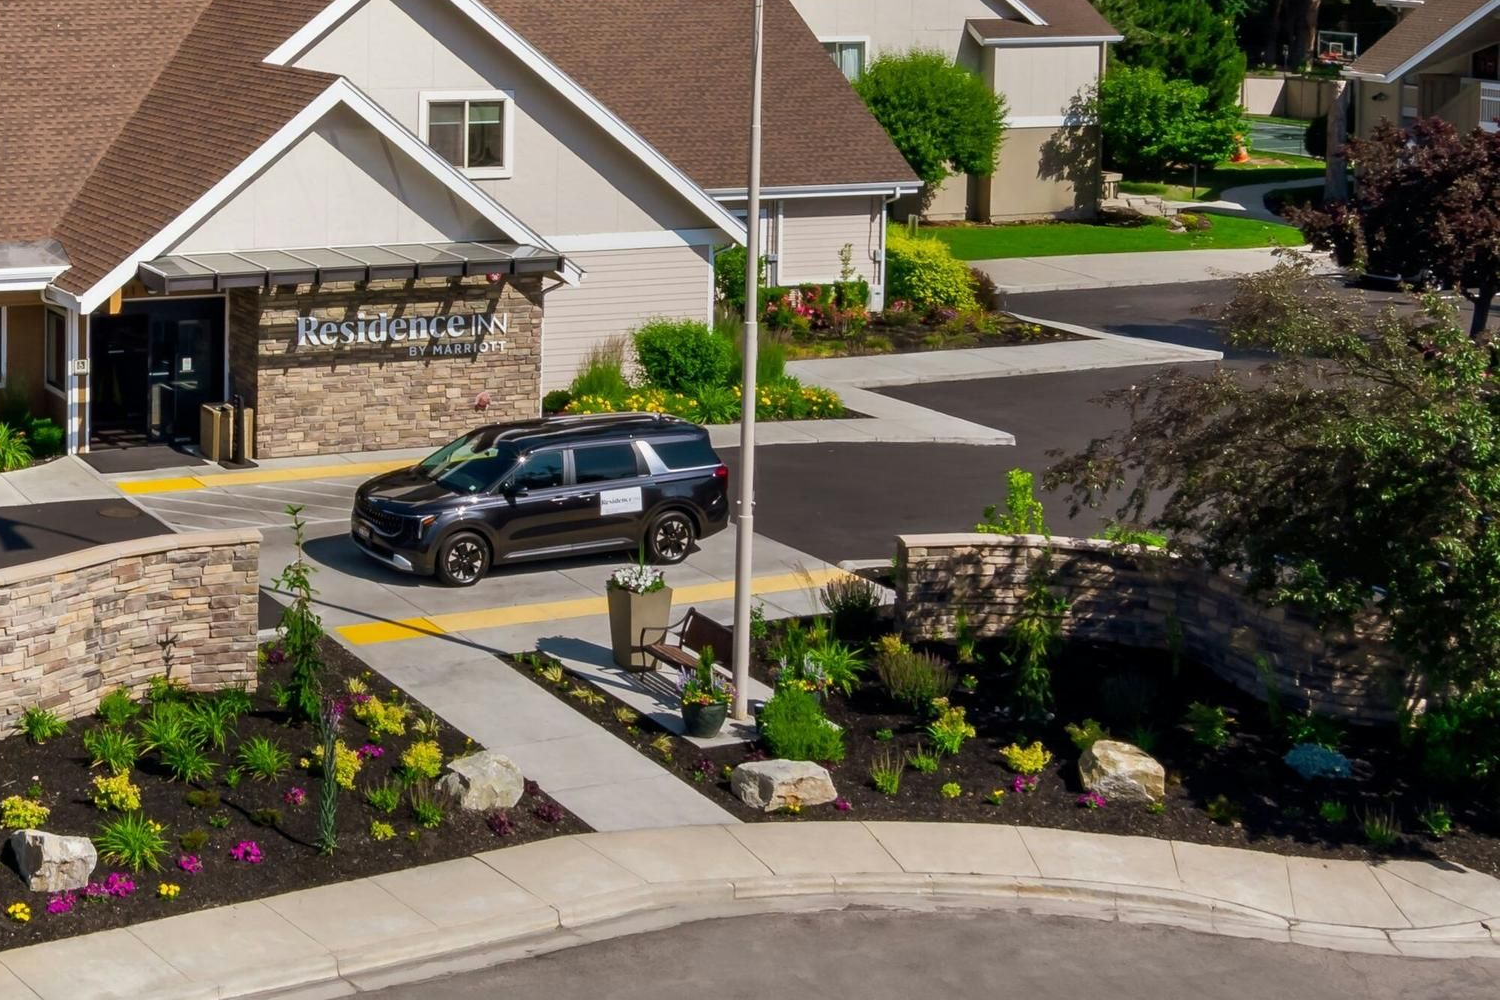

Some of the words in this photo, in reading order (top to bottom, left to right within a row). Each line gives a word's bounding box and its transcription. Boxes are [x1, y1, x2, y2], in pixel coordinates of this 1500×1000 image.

[297, 311, 465, 346] Residence
[471, 312, 508, 336] INN
[409, 346, 426, 357] BY
[433, 340, 506, 355] MARRIOTT
